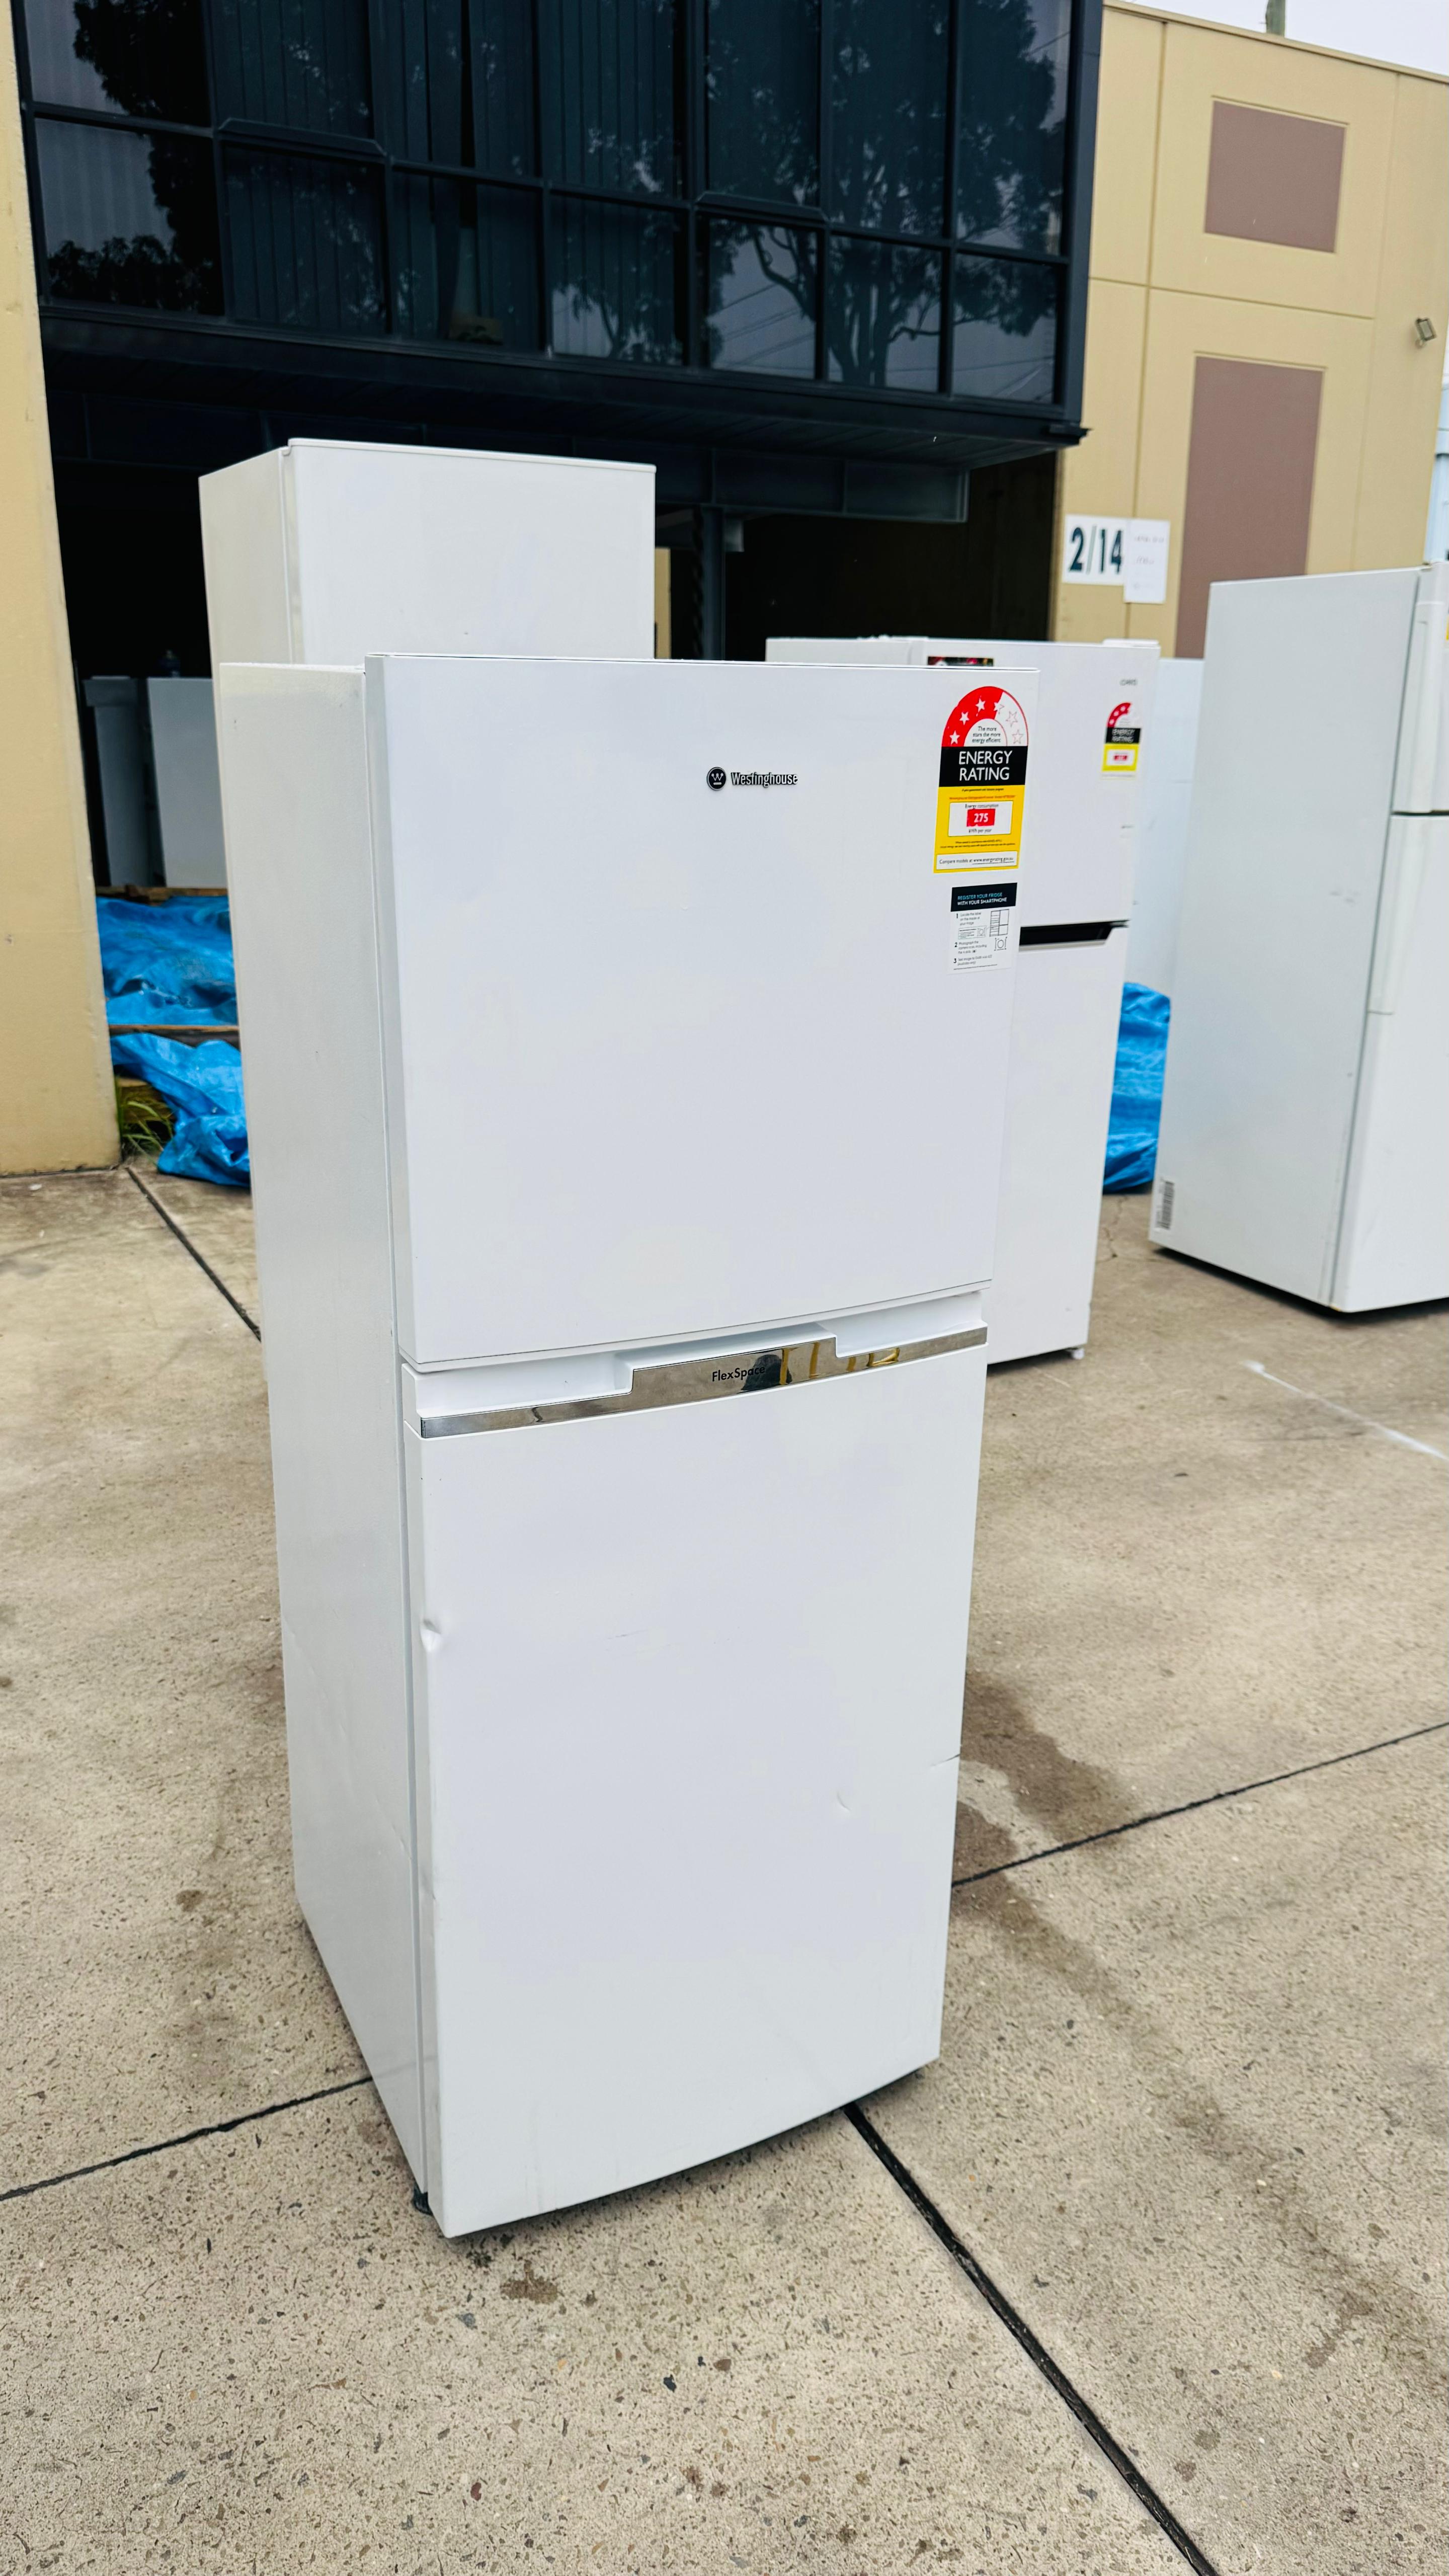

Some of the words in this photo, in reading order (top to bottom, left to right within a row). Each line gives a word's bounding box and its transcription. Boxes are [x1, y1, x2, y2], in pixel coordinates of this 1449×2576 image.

[1069, 526, 1122, 574] 2/14
[959, 750, 1013, 765] ENERGY
[731, 772, 798, 788] Westinghouse
[959, 767, 1010, 781] RATING
[974, 813, 989, 823] 275
[712, 1367, 765, 1382] FlexSpace
